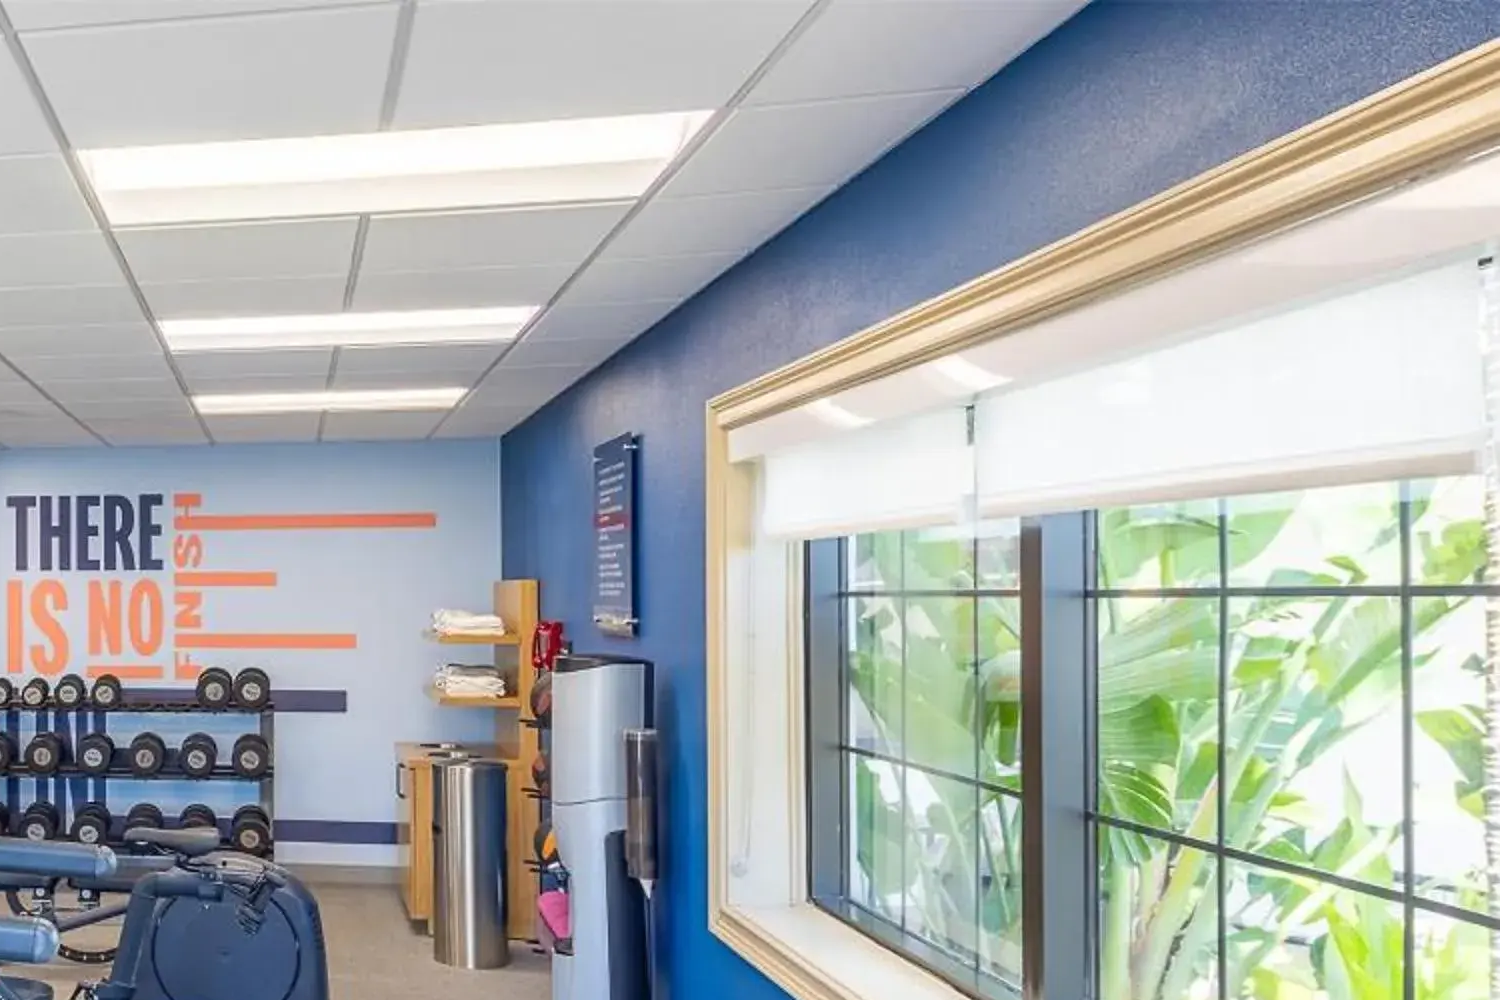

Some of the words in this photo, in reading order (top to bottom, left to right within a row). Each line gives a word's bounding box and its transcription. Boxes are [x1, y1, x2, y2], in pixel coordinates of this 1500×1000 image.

[6, 494, 164, 571] THERE
[6, 578, 69, 676] IS
[87, 578, 164, 657] NO
